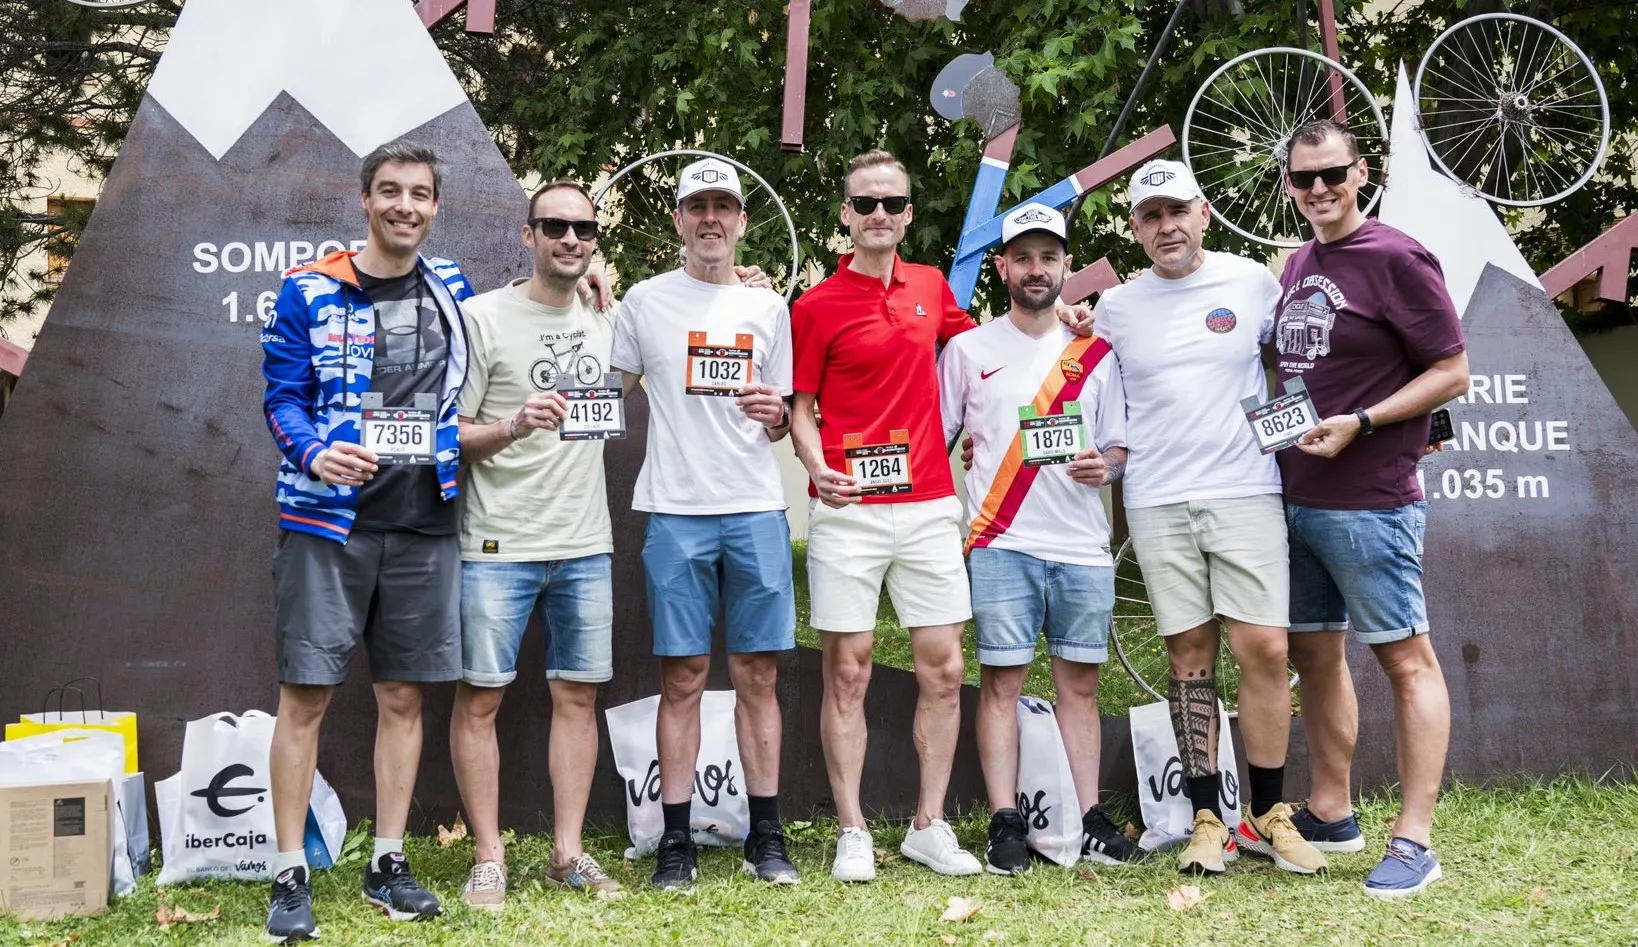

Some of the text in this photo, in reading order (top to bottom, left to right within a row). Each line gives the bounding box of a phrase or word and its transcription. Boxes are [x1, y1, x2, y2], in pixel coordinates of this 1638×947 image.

[192, 241, 368, 273] SOMP
[1302, 274, 1348, 310] OBSESSION
[699, 359, 742, 381] 1032
[1457, 375, 1529, 405] RIE
[570, 401, 614, 423] 4192
[1261, 406, 1306, 437] 8623
[374, 424, 423, 446] 7356
[1032, 428, 1075, 450] 1879
[858, 457, 902, 479] 1264
[1416, 468, 1550, 500] 1.035 m
[185, 830, 267, 849] iberCaja
[196, 865, 218, 873] BANCO
